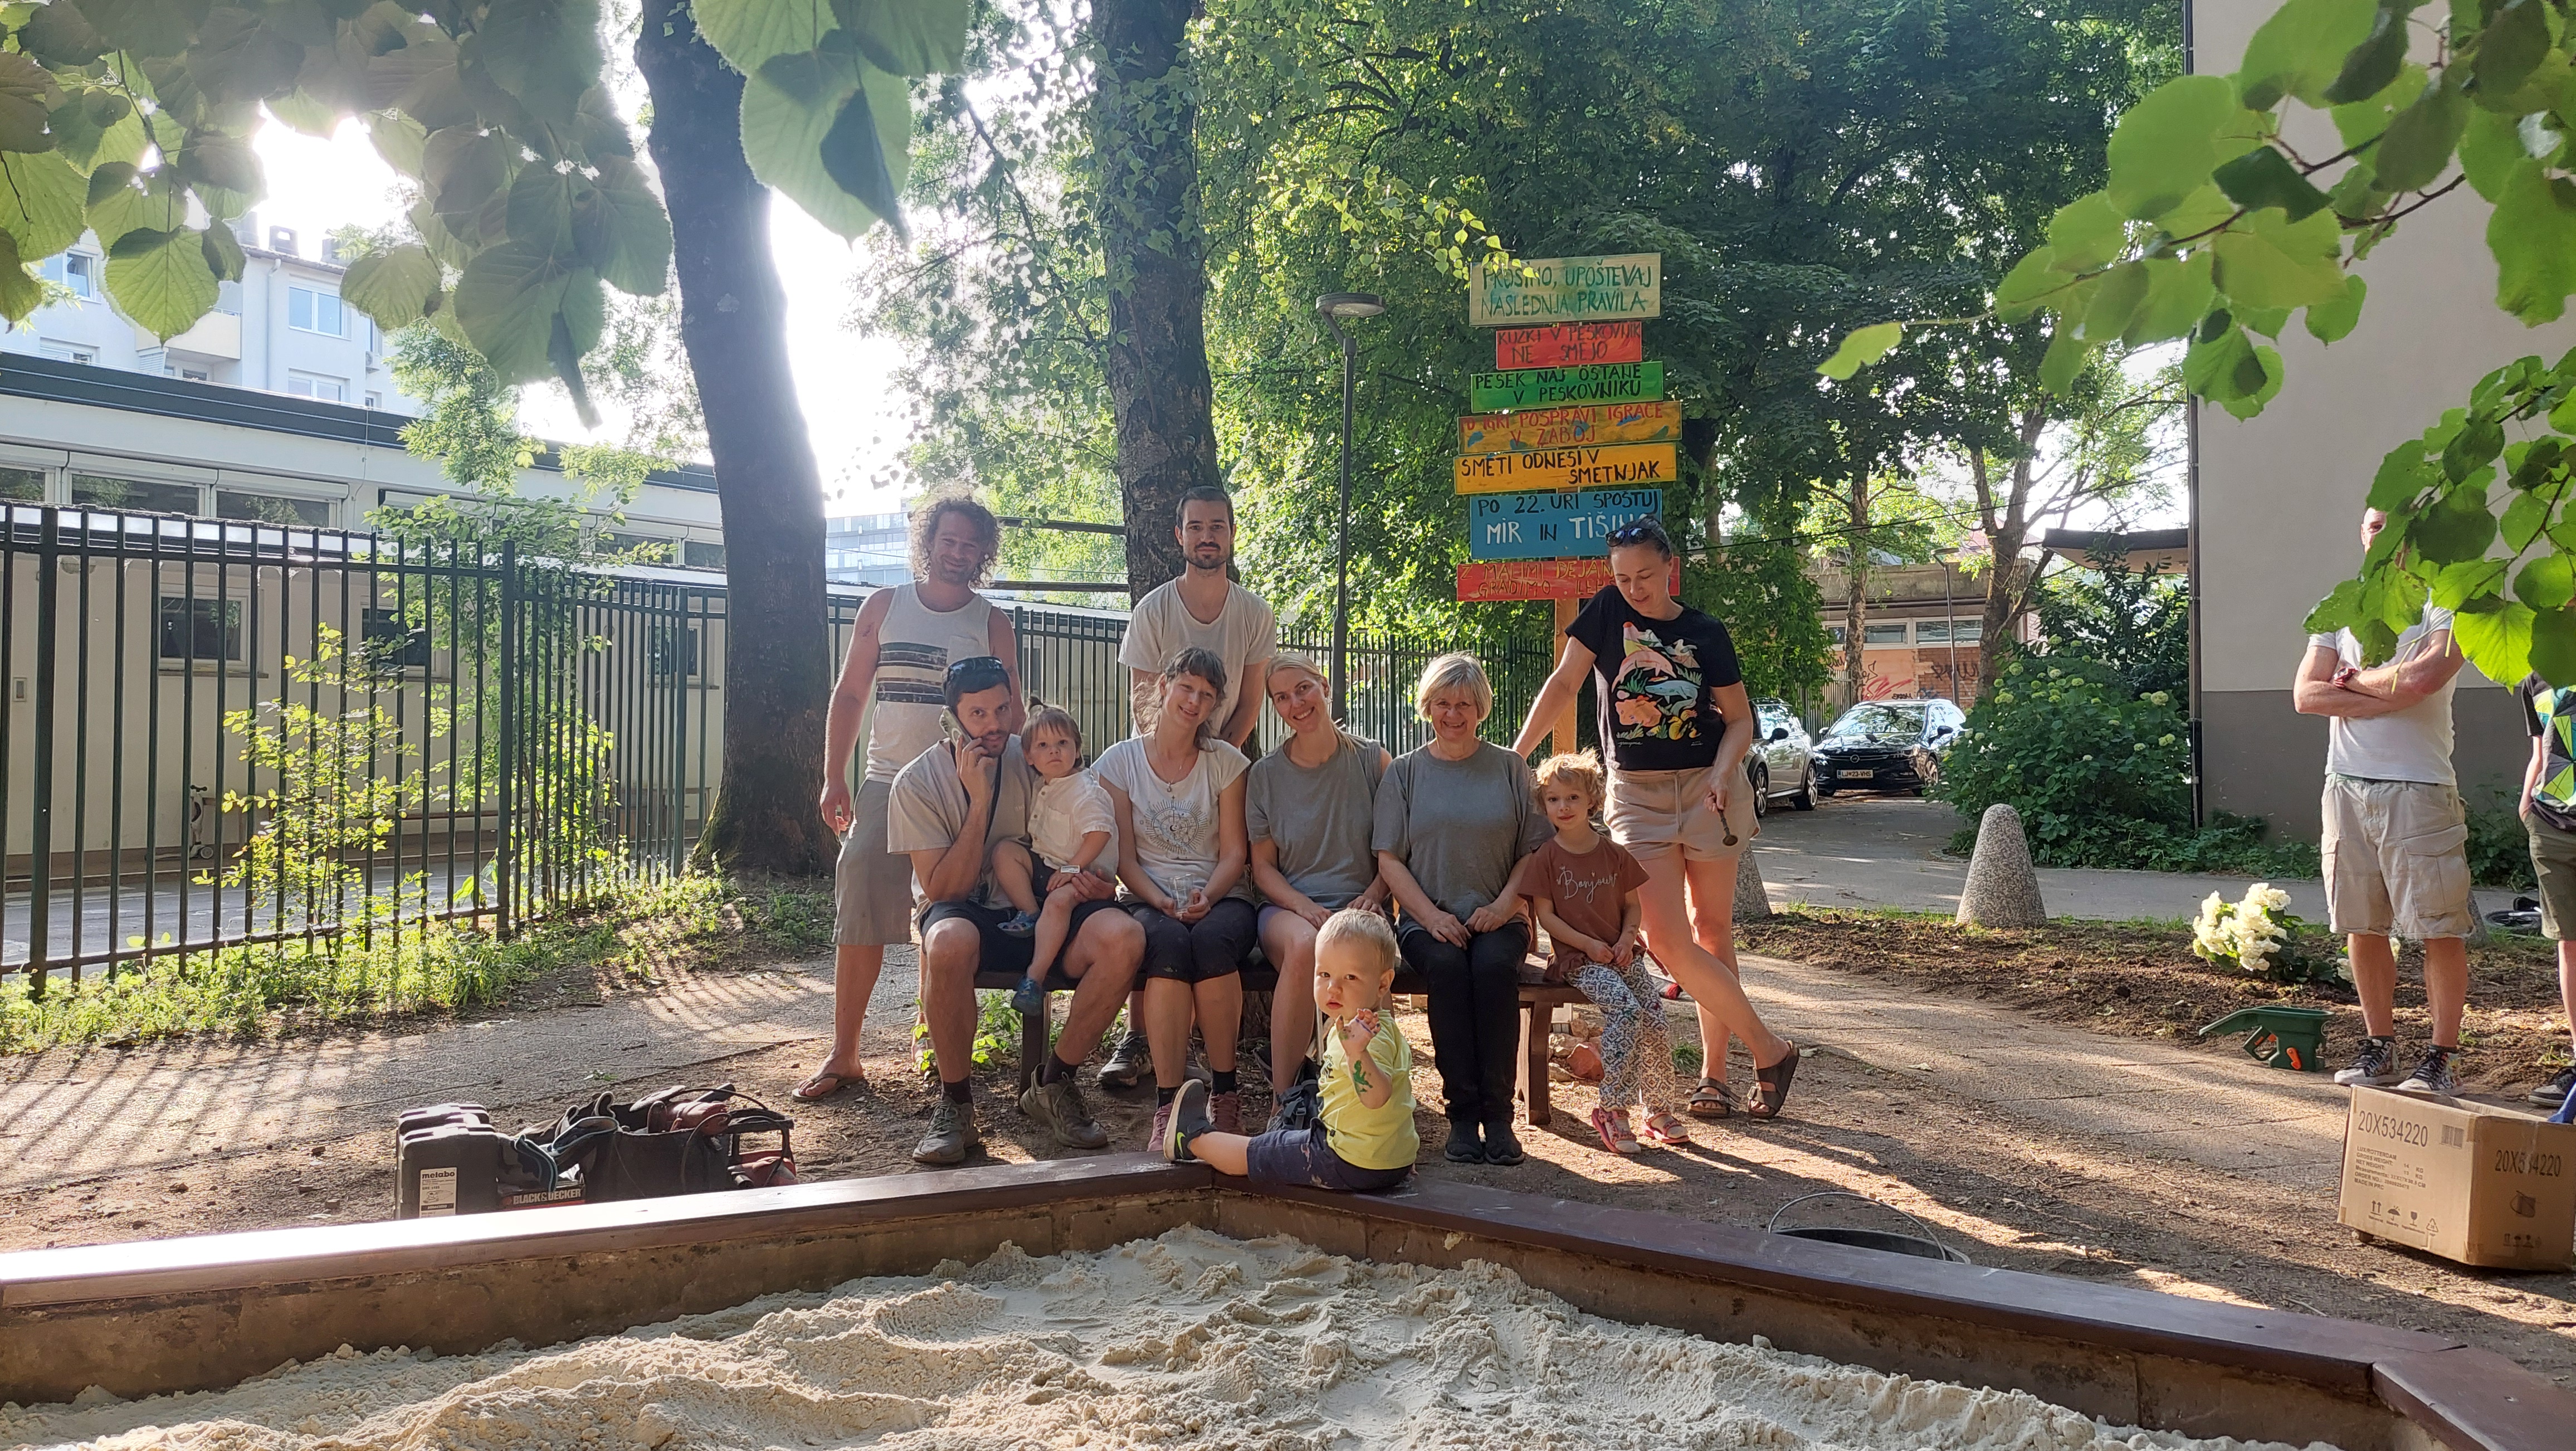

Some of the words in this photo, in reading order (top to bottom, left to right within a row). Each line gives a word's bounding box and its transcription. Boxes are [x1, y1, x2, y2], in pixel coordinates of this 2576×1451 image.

[1565, 259, 1652, 288] UPOŠTEVAJ
[1481, 293, 1569, 320] NASLEDNJA
[1577, 289, 1648, 313] PRAVILA
[1550, 328, 1561, 341] V
[1569, 322, 1641, 342] PESKOVNIK
[1512, 345, 1534, 364] NE
[1560, 340, 1608, 361] SMEJO
[1476, 372, 1526, 390] PESEK
[1536, 369, 1566, 384] NAJ
[1579, 364, 1641, 381] OSTANE
[1513, 390, 1525, 405] V
[1539, 381, 1641, 402] PESKOVNIKU
[1461, 417, 1476, 433] PO
[1482, 414, 1510, 431] IGRI
[1520, 407, 1596, 428] POSPRAVI
[1510, 430, 1521, 447] V
[1536, 424, 1596, 449] ZABOJ
[1461, 456, 1512, 478] SMETI
[1522, 450, 1582, 470] ODNESI
[1587, 449, 1601, 465] V
[1568, 460, 1661, 485] SMETNJAK
[1479, 499, 1500, 517] PO
[1514, 495, 1545, 514] 22.
[1550, 493, 1579, 510] URI
[1593, 490, 1658, 514] SPOŠTUJ
[1487, 518, 1523, 545] MIR
[1539, 523, 1558, 542] IN
[1568, 512, 1647, 539] TIŠIN
[1460, 564, 1473, 580] Z
[1484, 562, 1544, 581] MALIMI
[1556, 560, 1614, 578] DEJAN
[1478, 580, 1551, 599] GRADIMO
[1557, 865, 1618, 903] Bonjour
[2358, 1110, 2428, 1147] 20X534220
[2357, 1152, 2373, 1161] GROSS
[2495, 1150, 2561, 1177] 20X54220
[422, 1171, 455, 1179] metabo
[2354, 1171, 2372, 1180] ORDER
[2354, 1177, 2368, 1186] MADE
[513, 1188, 582, 1205] BLACK&DECKER
